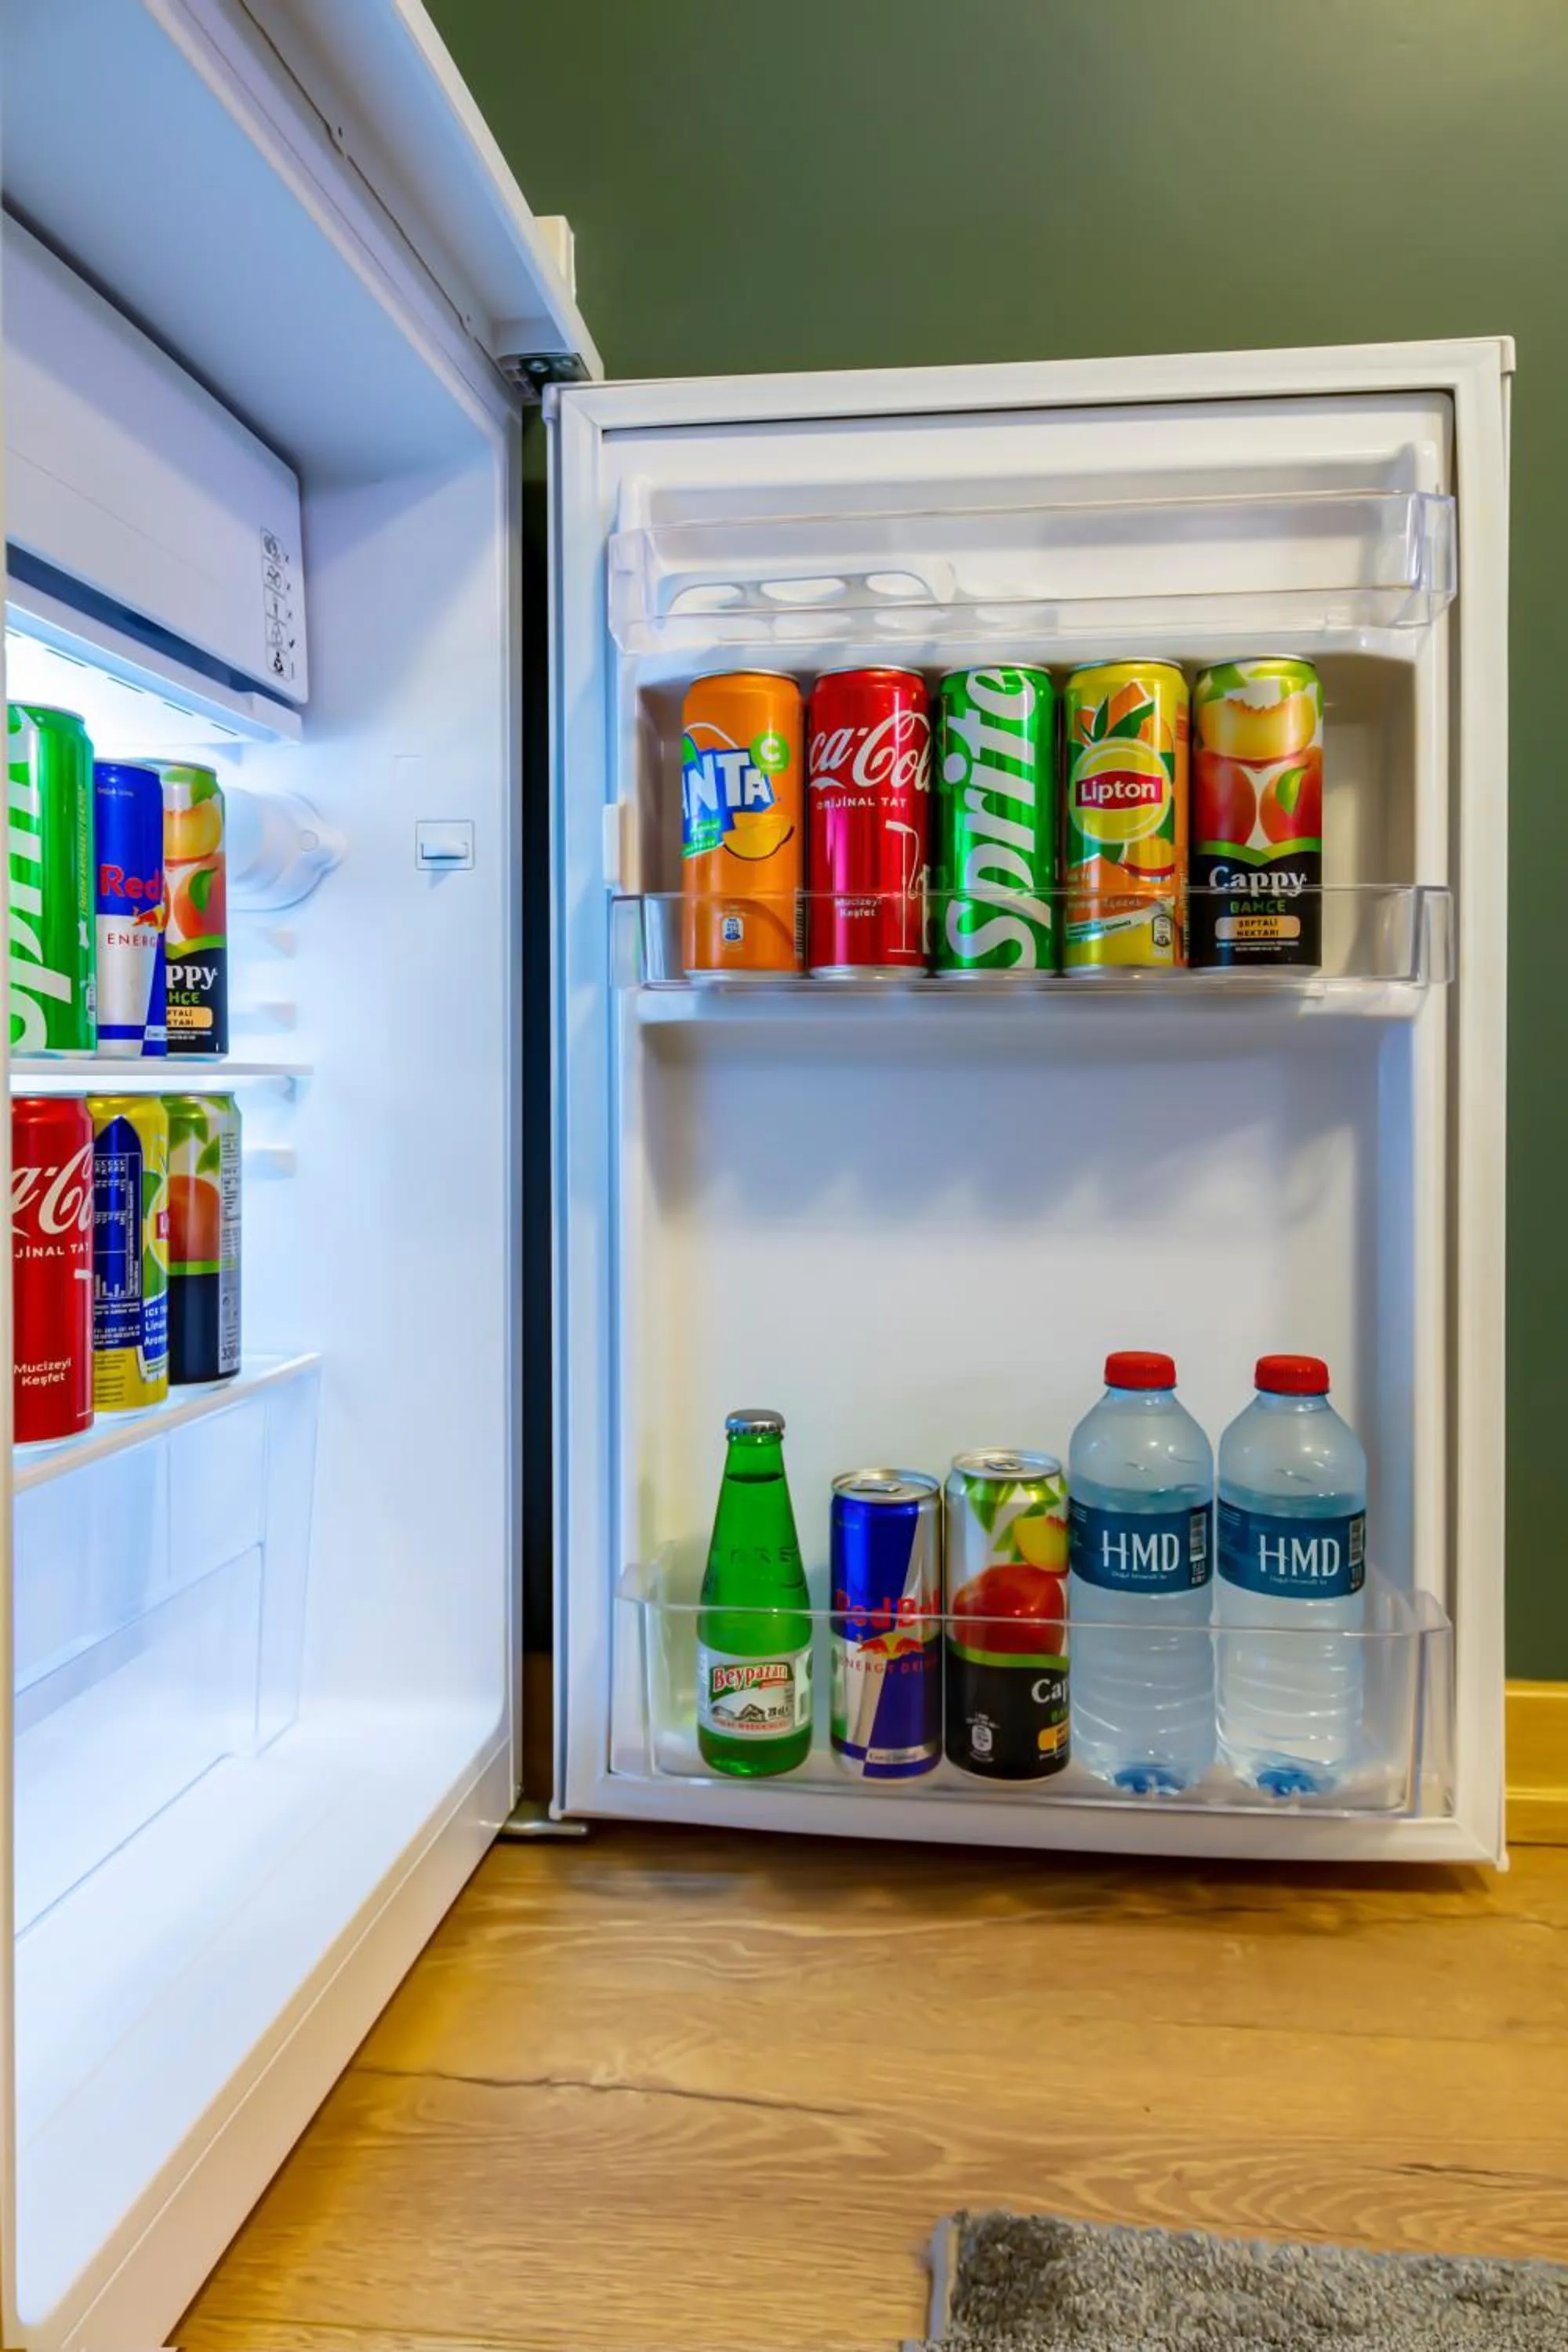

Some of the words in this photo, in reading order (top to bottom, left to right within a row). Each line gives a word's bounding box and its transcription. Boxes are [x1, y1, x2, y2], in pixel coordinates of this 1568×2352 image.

[760, 737, 781, 762] C
[880, 797, 907, 808] TAT
[1081, 781, 1155, 804] Lipton
[945, 669, 1051, 968] Sprite
[100, 864, 162, 901] Red
[1209, 866, 1308, 898] Cappy
[1099, 1530, 1180, 1572] HMD
[1258, 1534, 1340, 1577] HMD
